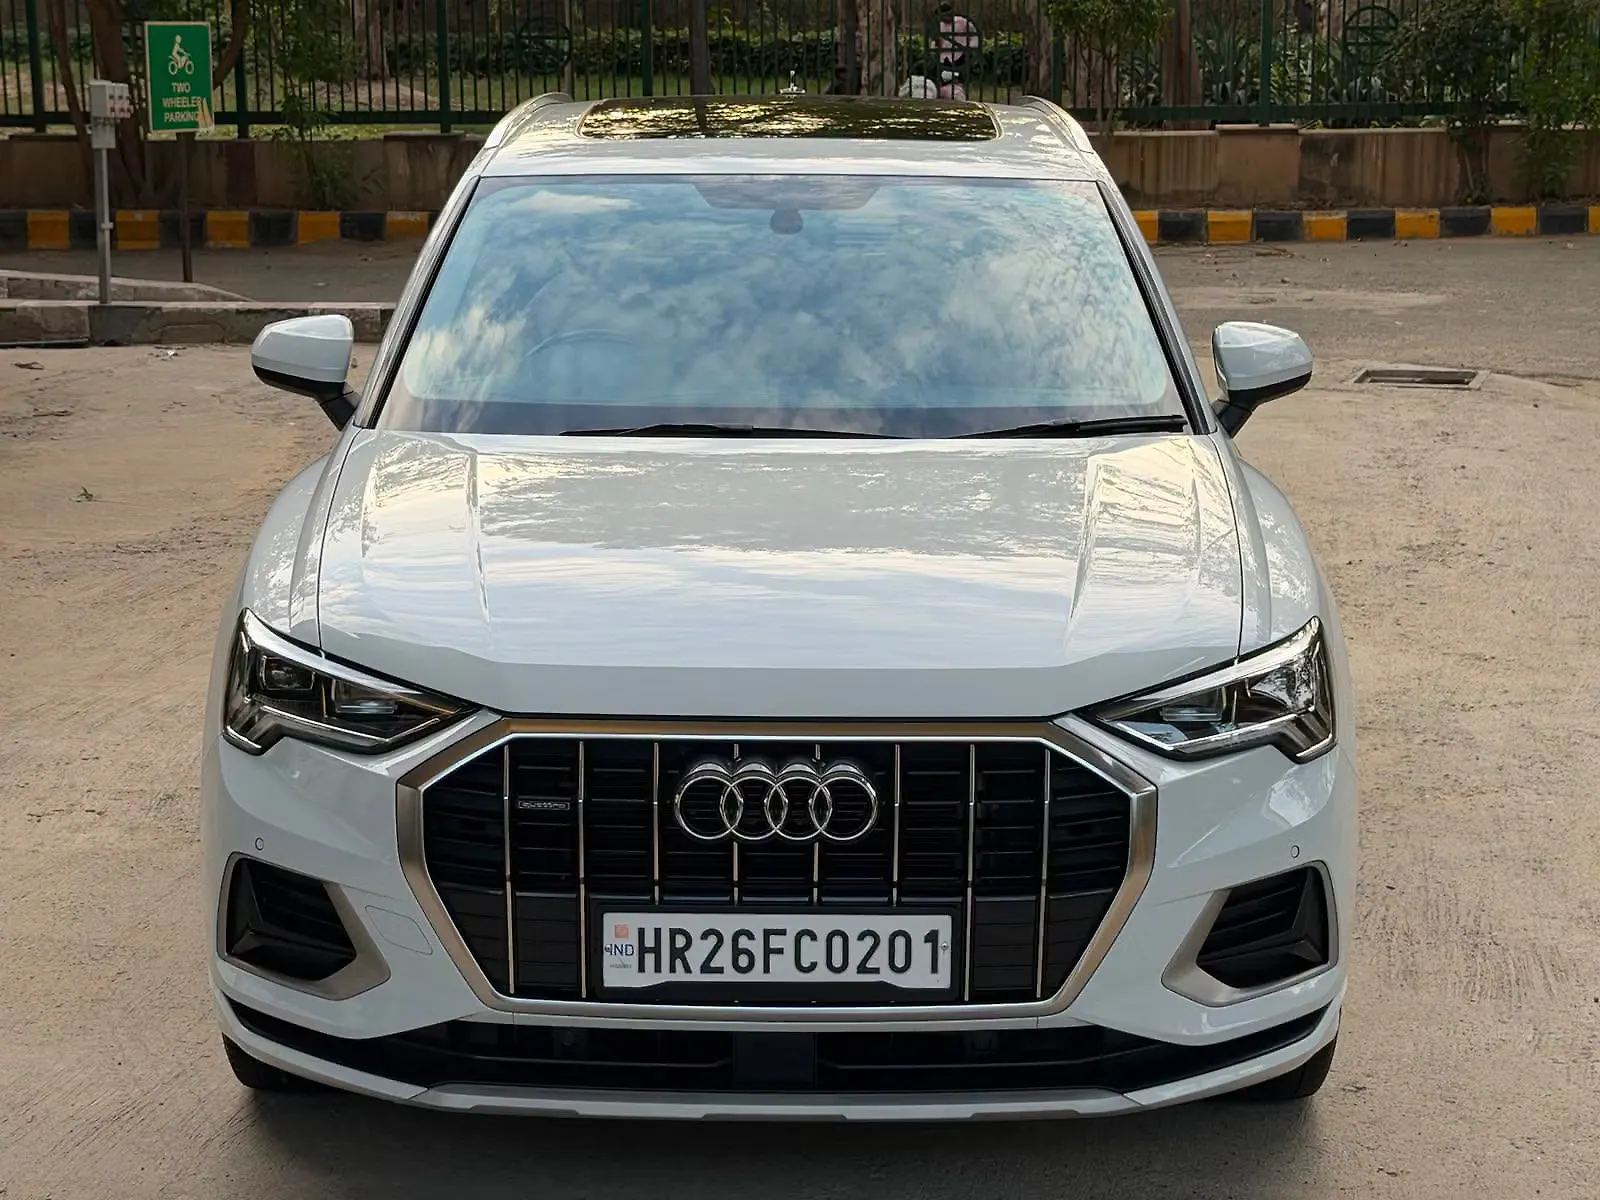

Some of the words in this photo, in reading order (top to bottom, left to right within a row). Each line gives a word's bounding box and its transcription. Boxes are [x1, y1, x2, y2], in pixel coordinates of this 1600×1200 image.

[171, 82, 191, 93] TWO
[162, 96, 202, 108] WHEELER
[637, 927, 939, 974] HR26FC0201
